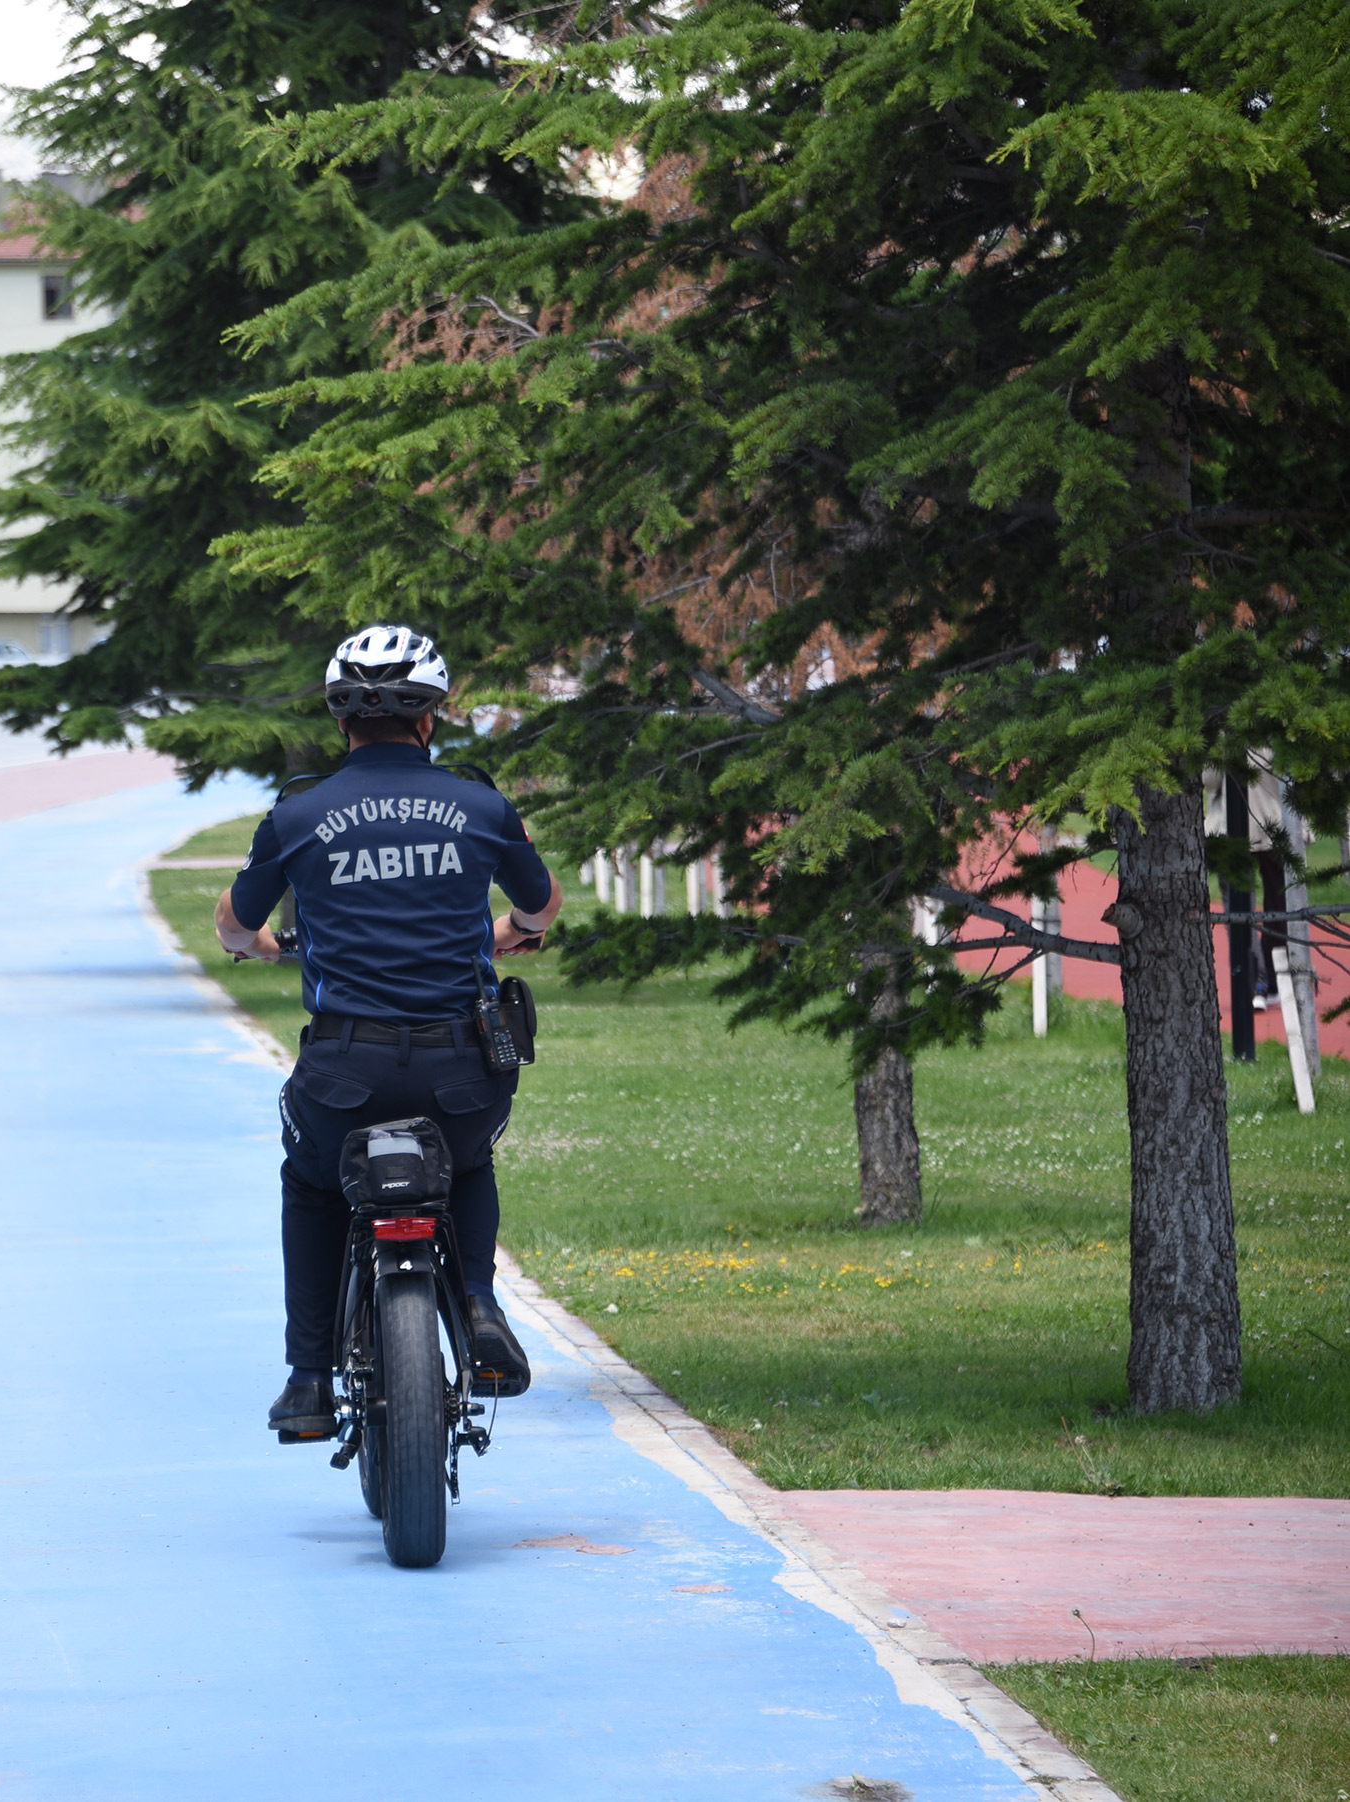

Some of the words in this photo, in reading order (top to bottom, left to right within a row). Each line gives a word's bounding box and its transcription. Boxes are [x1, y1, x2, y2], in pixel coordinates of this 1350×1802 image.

[314, 797, 468, 845] BÜYÜKŞEHİR
[328, 842, 464, 886] ZABITA
[399, 1260, 413, 1271] 4
